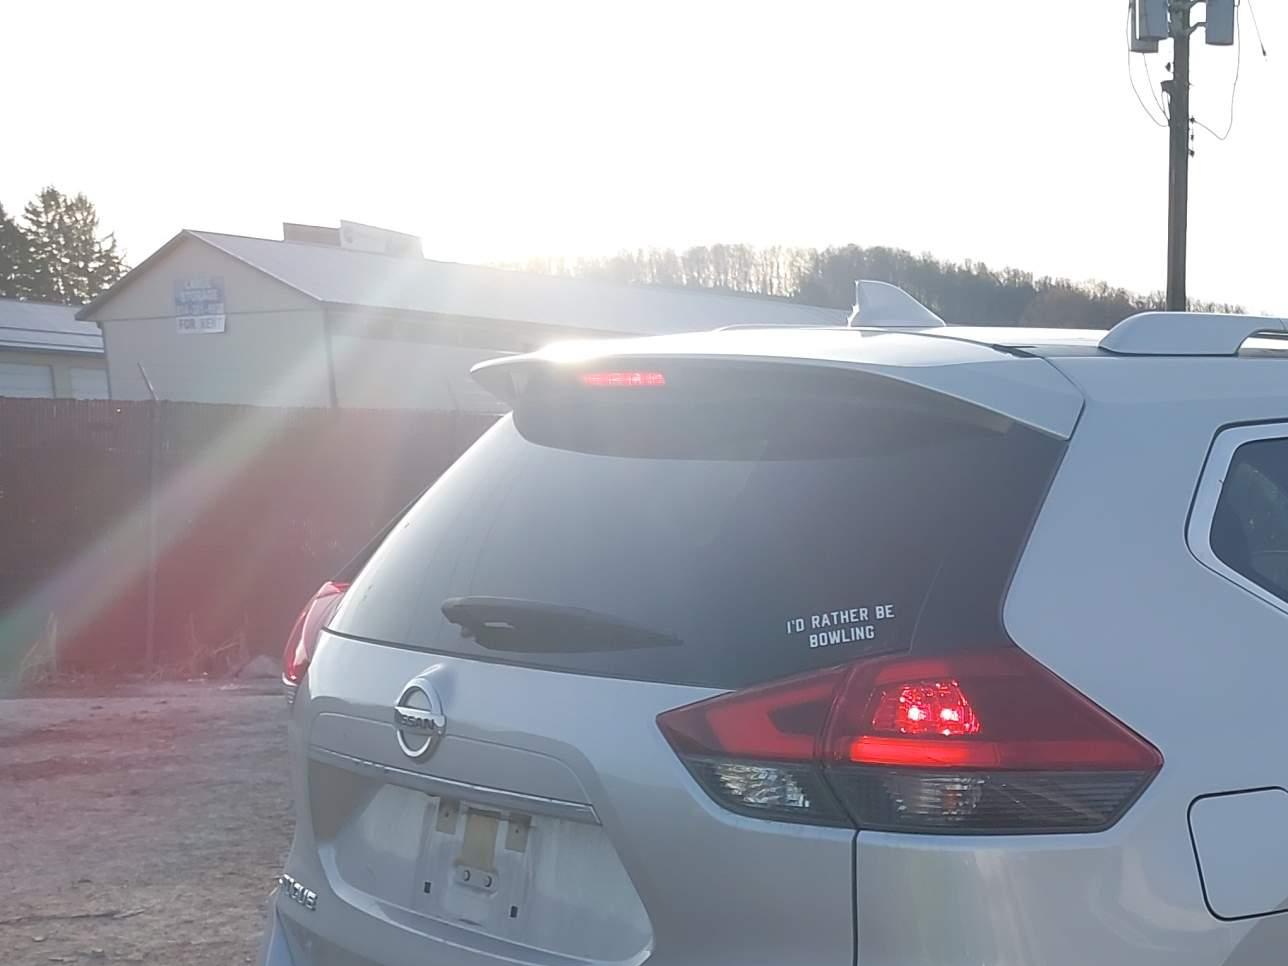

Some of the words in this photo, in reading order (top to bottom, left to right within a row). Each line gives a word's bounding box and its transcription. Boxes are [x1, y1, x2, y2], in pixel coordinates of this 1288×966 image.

[786, 618, 805, 634] I'D
[811, 607, 869, 629] RATHER
[875, 604, 896, 620] BE
[809, 625, 875, 648] BOWLING
[278, 873, 318, 910] GUE
